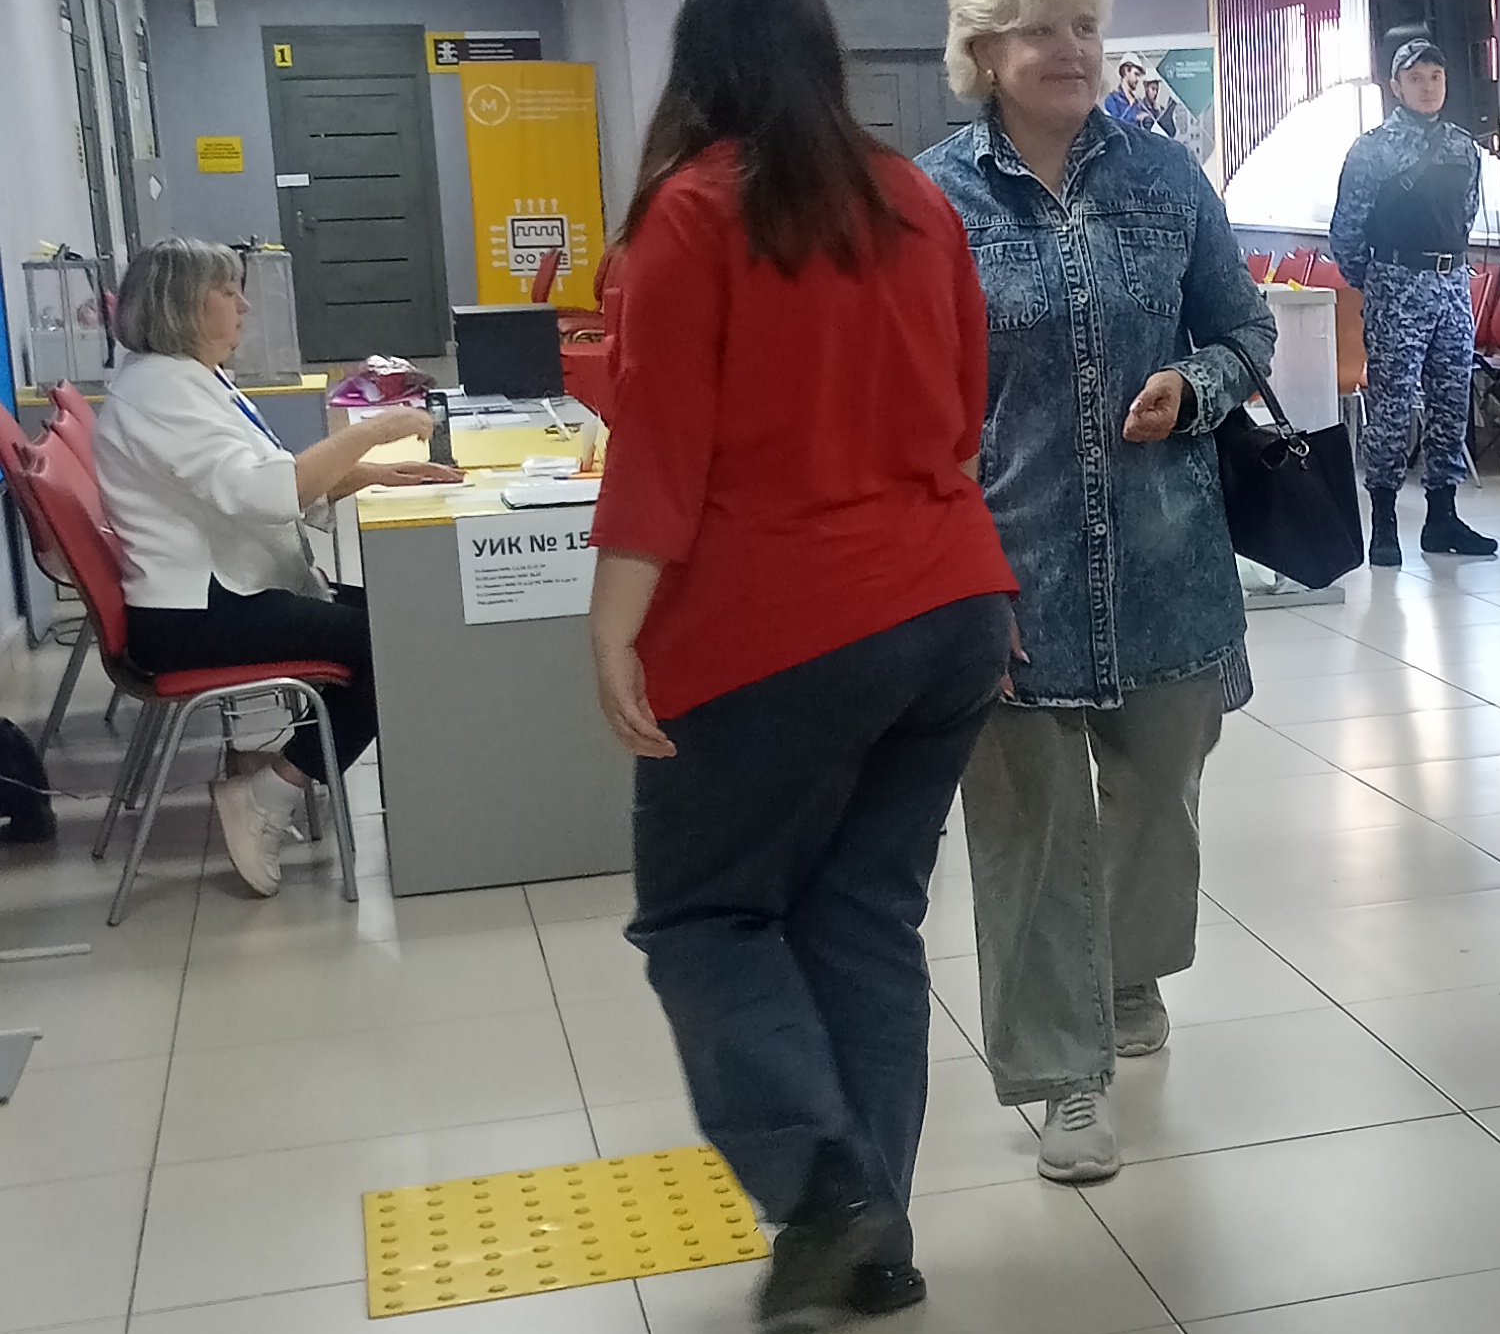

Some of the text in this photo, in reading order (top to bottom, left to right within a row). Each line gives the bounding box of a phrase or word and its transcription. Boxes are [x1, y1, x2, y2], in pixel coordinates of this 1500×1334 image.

[278, 48, 288, 63] 1
[472, 535, 523, 558] УИК
[529, 533, 558, 553] №
